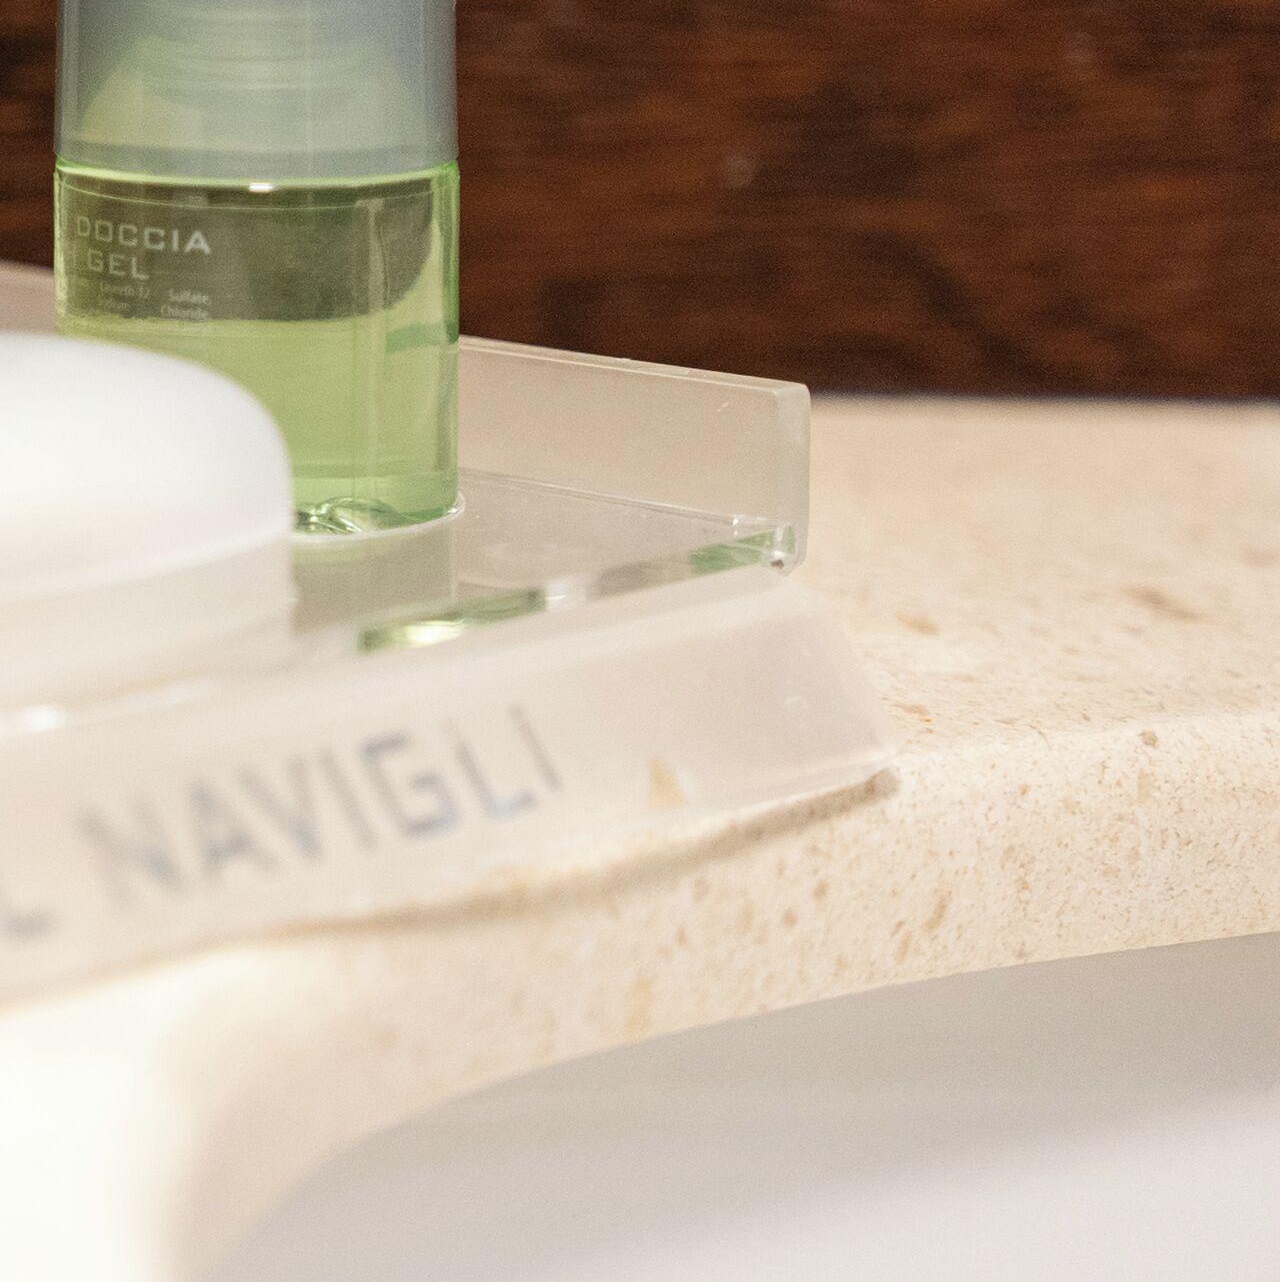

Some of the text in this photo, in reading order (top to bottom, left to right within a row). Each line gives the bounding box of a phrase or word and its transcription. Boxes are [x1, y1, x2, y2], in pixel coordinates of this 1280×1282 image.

[76, 216, 211, 255] DOCCIA
[88, 249, 150, 280] GEL
[75, 704, 562, 913] NAVIGLI
